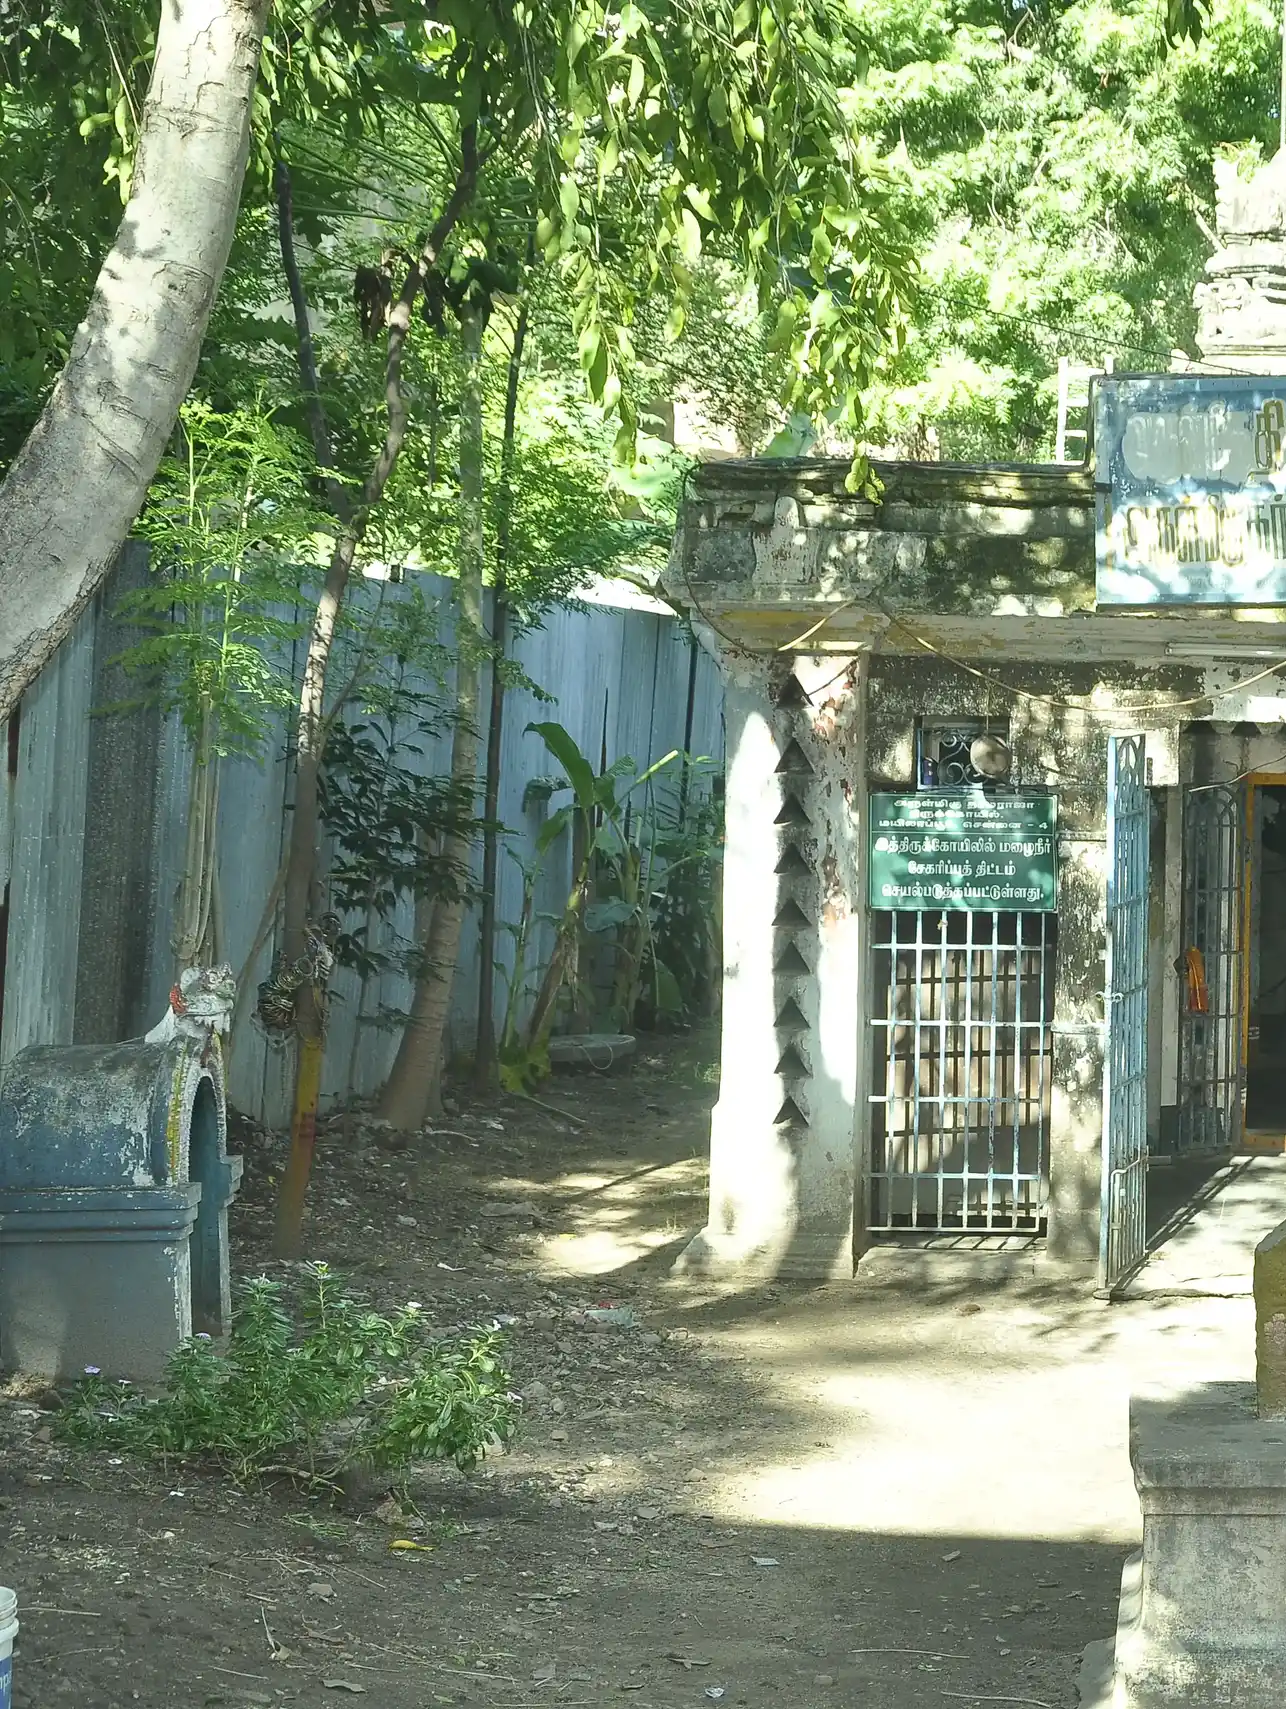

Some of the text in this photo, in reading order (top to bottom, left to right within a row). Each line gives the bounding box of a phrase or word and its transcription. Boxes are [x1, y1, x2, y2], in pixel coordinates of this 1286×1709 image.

[1039, 822, 1048, 830] 4
[874, 835, 1051, 856] இத்திருக்கோயிலில் மழைநீர்
[975, 859, 1016, 878] திட்டம்
